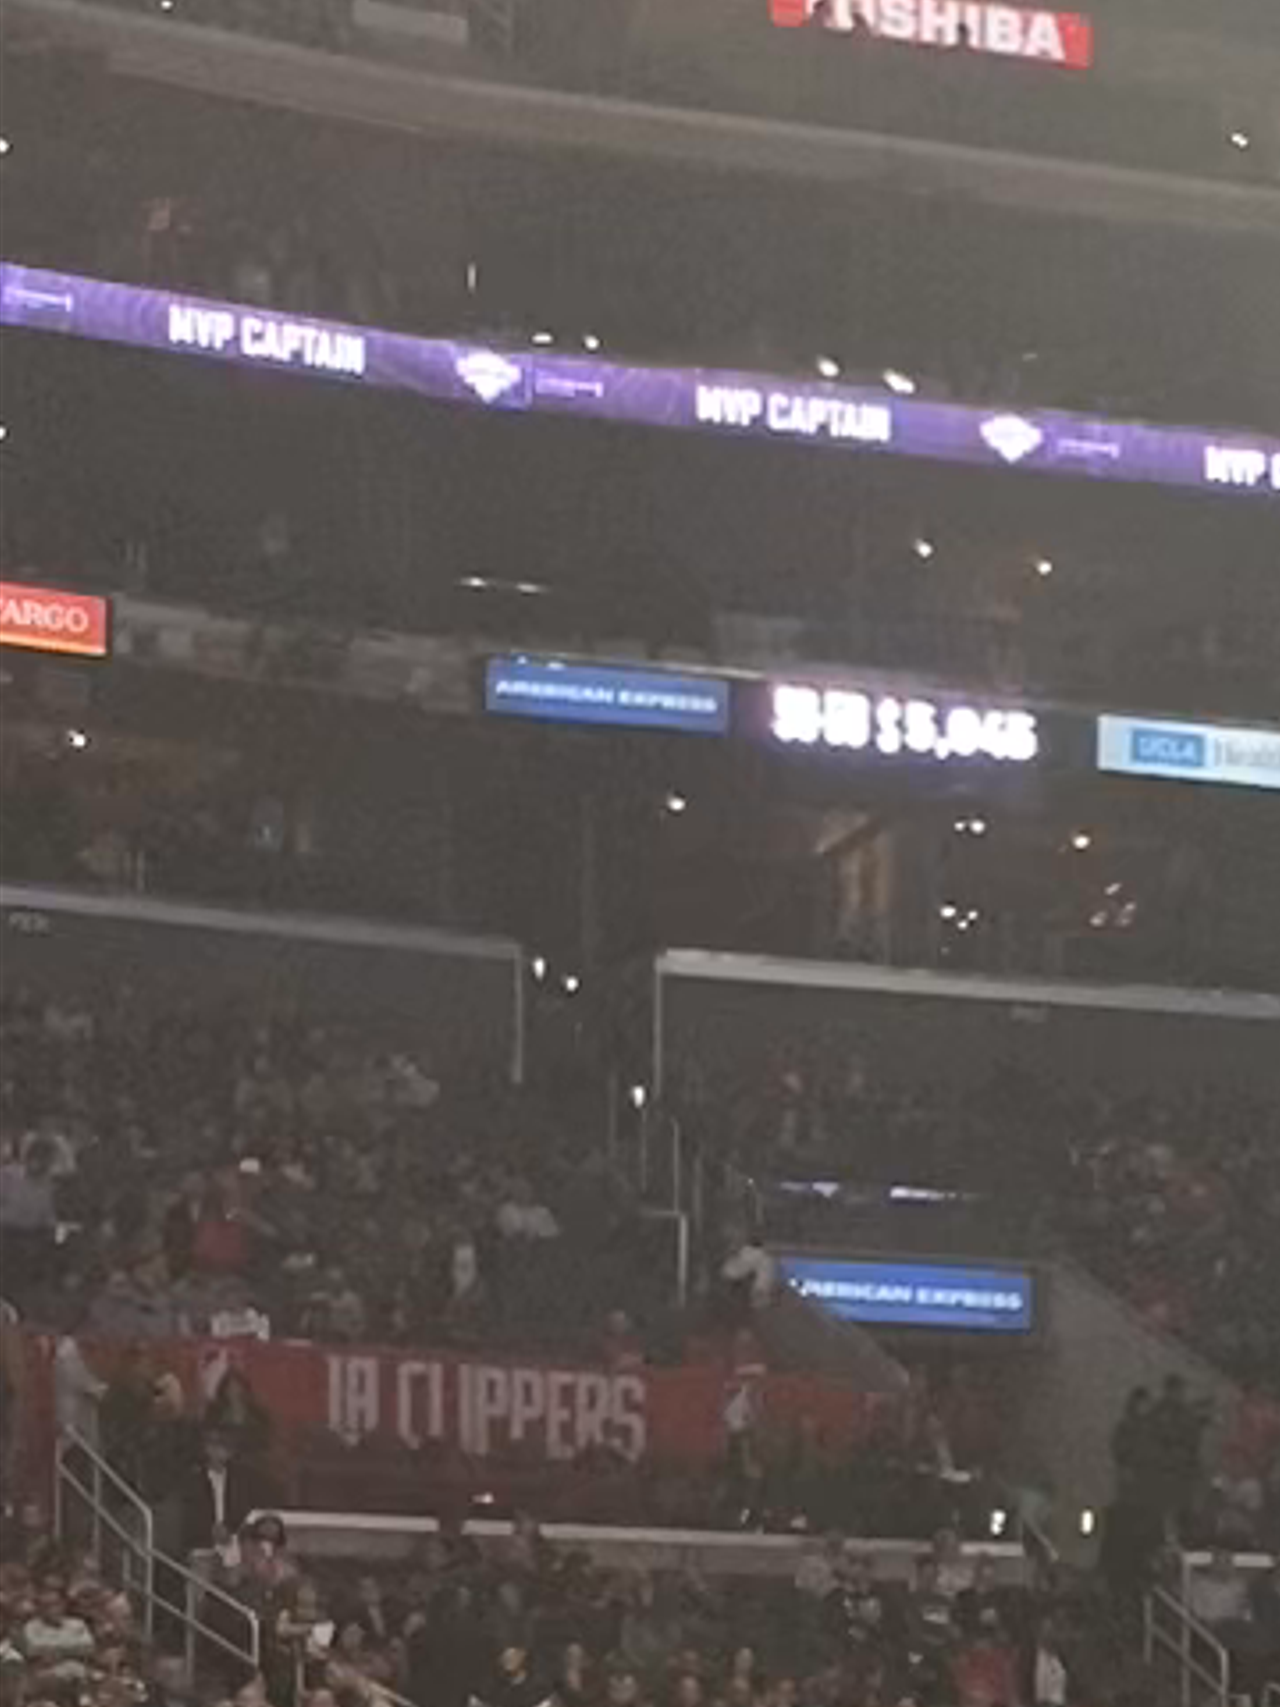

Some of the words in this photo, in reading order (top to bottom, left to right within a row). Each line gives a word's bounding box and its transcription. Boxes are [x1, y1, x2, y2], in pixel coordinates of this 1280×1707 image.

[168, 303, 236, 350] MVP
[240, 314, 365, 375] CAPTAIN
[695, 384, 761, 427] MVP
[767, 393, 891, 442] CAPTAIN
[1204, 446, 1265, 486] MVP
[0, 599, 89, 633] ARGO
[396, 1359, 647, 1463] CLIPPERS
